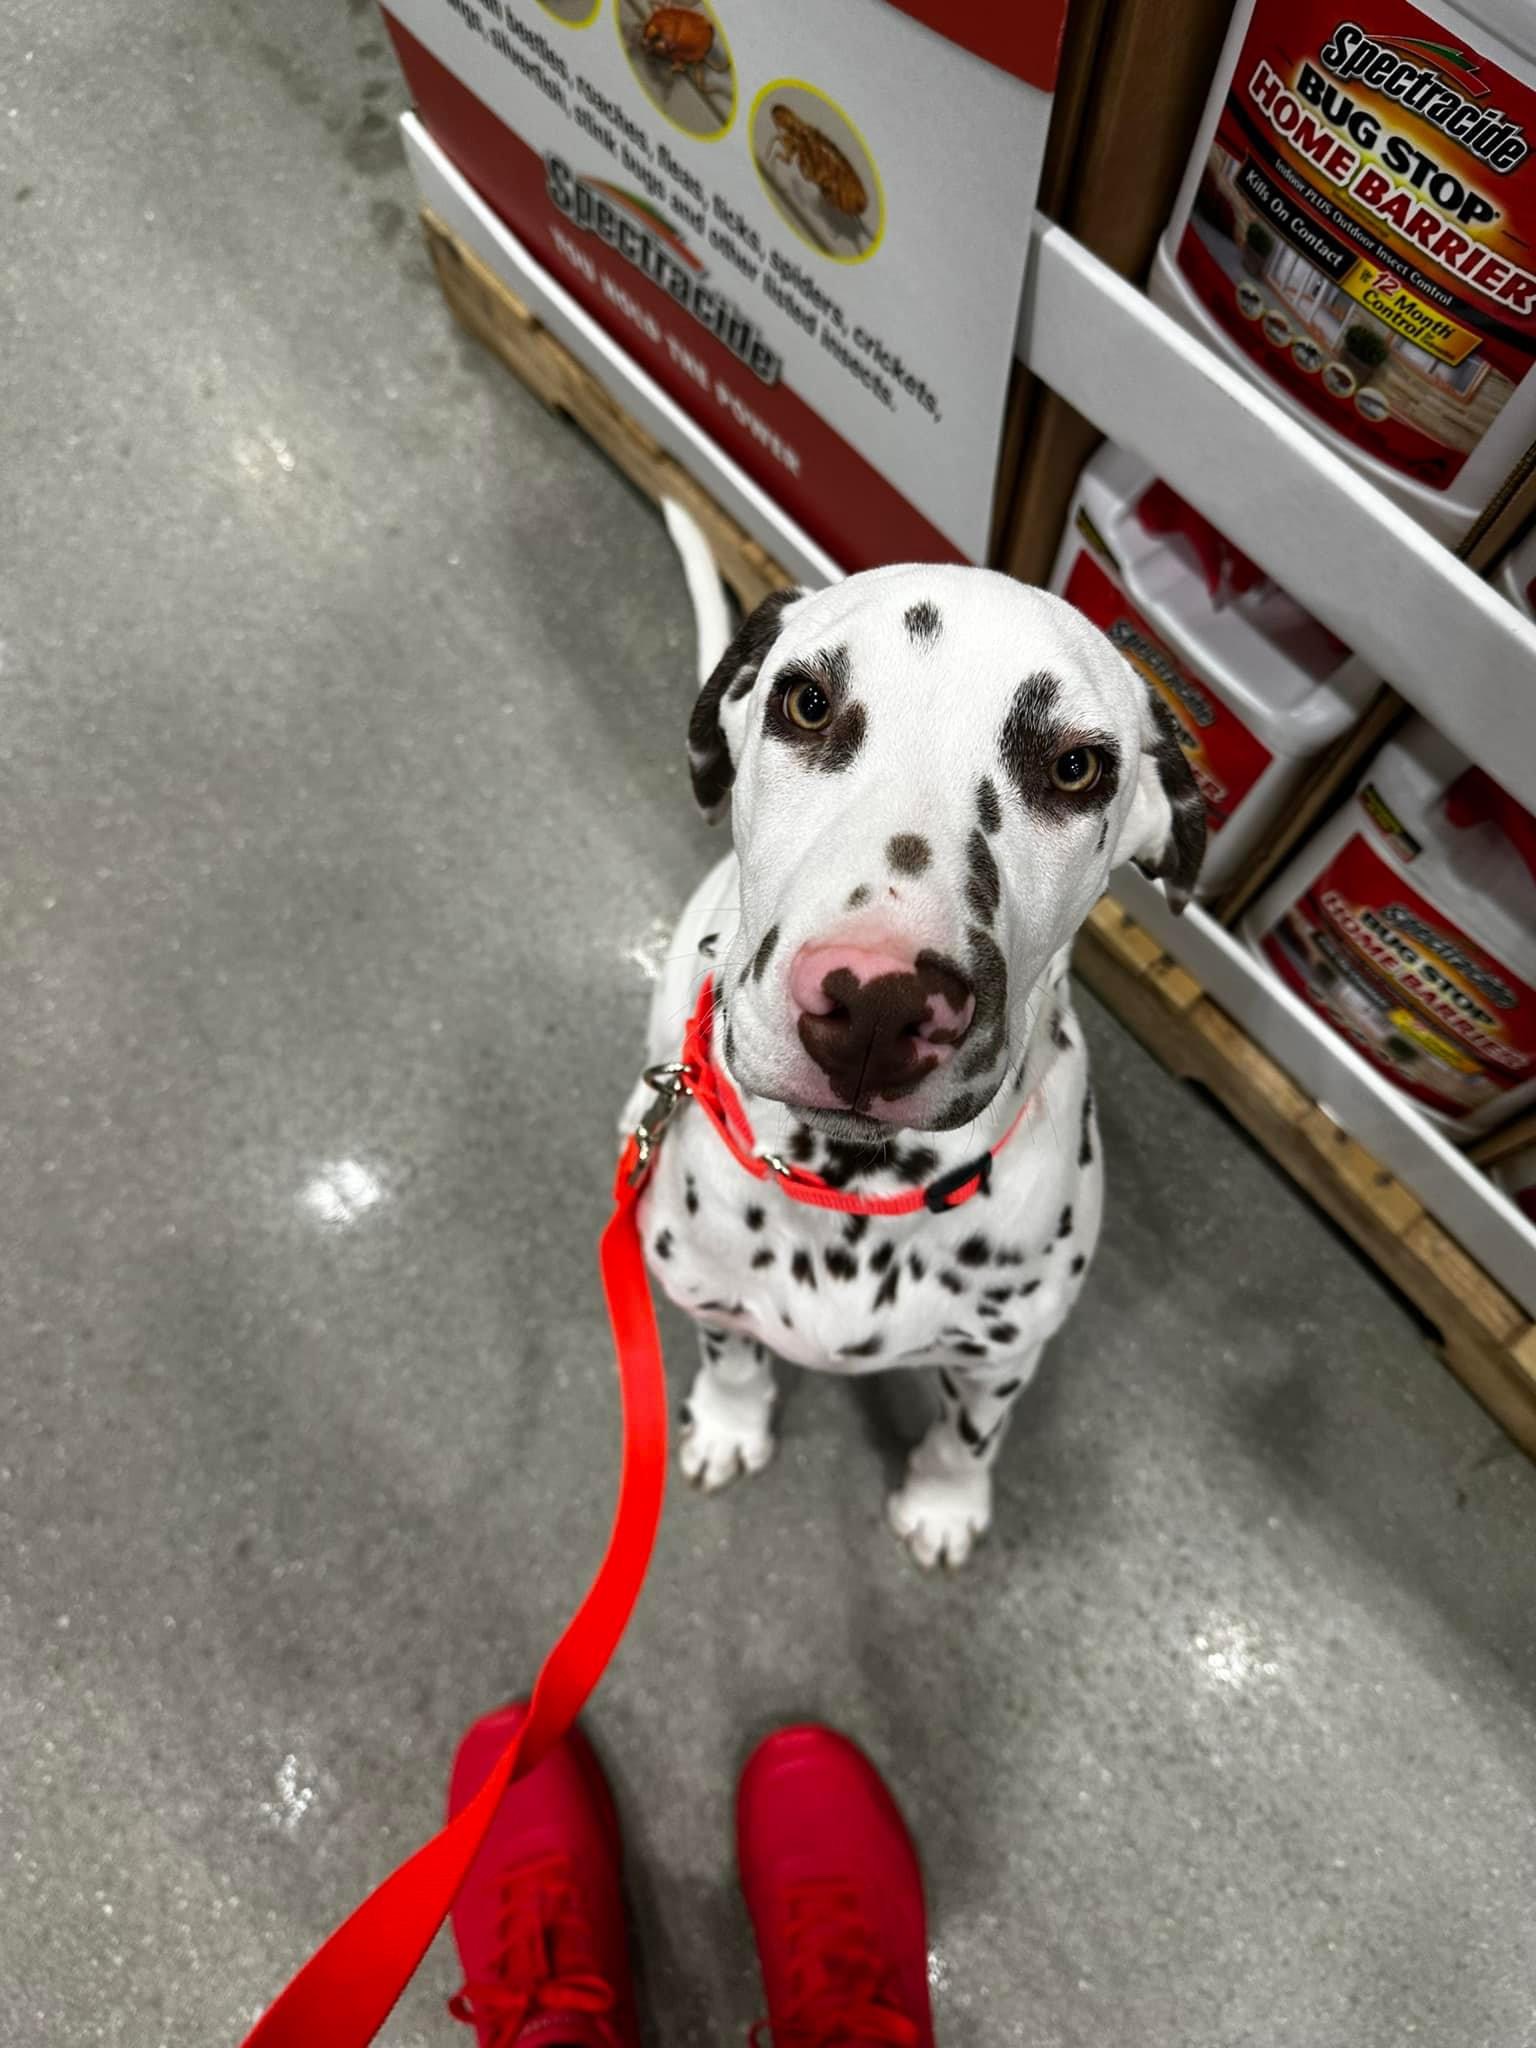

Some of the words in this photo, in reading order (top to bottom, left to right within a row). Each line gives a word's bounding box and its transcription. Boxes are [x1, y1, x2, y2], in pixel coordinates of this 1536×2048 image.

[1297, 62, 1382, 150] BUG
[1381, 135, 1498, 224] STOP
[1321, 22, 1528, 173] Spectracide
[576, 75, 654, 164] roaches,
[657, 143, 709, 212] fleas,
[713, 194, 766, 263] ticks,
[770, 249, 848, 337] spiders,
[853, 323, 941, 424] crickets,
[1245, 168, 1271, 203] Kills
[1269, 197, 1291, 222] On
[1290, 216, 1345, 268] Contact
[1249, 60, 1361, 187] HOME
[1350, 161, 1536, 316] BARRIER
[1274, 157, 1306, 193] Indoor
[1304, 187, 1335, 216] PLUS
[1332, 210, 1377, 251] Outdoor
[1375, 245, 1408, 280] Insect
[1409, 271, 1455, 307] Control
[549, 155, 778, 384] Spectracide
[621, 143, 667, 202] bugs
[671, 194, 706, 236] and
[709, 229, 758, 283] other
[763, 270, 818, 338] listed
[820, 323, 897, 413] insects.
[1362, 287, 1425, 339] Control
[1370, 271, 1401, 297] 12
[1396, 294, 1456, 340] Month
[1322, 889, 1399, 972] HOME
[1400, 971, 1531, 1070] BARRIER
[1361, 911, 1418, 964] BUG
[1421, 963, 1496, 1026] STOP
